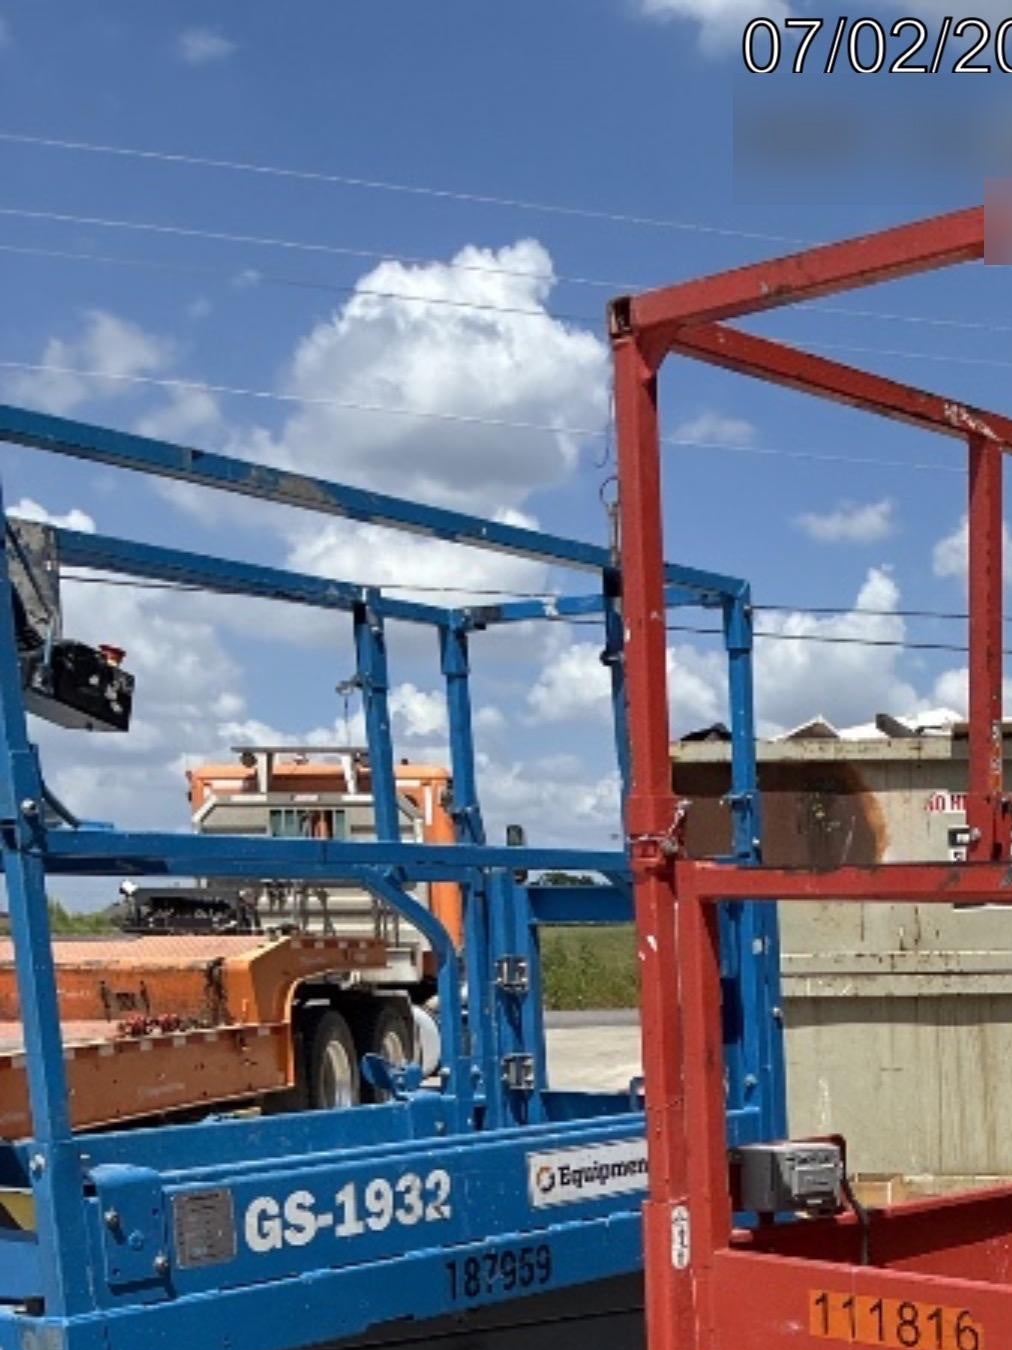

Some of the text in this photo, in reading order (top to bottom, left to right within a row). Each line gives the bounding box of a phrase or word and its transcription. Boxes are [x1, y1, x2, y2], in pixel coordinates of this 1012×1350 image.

[557, 1157, 648, 1189] Equipmen
[245, 1169, 452, 1252] GS-1932
[446, 1245, 552, 1301] 187959
